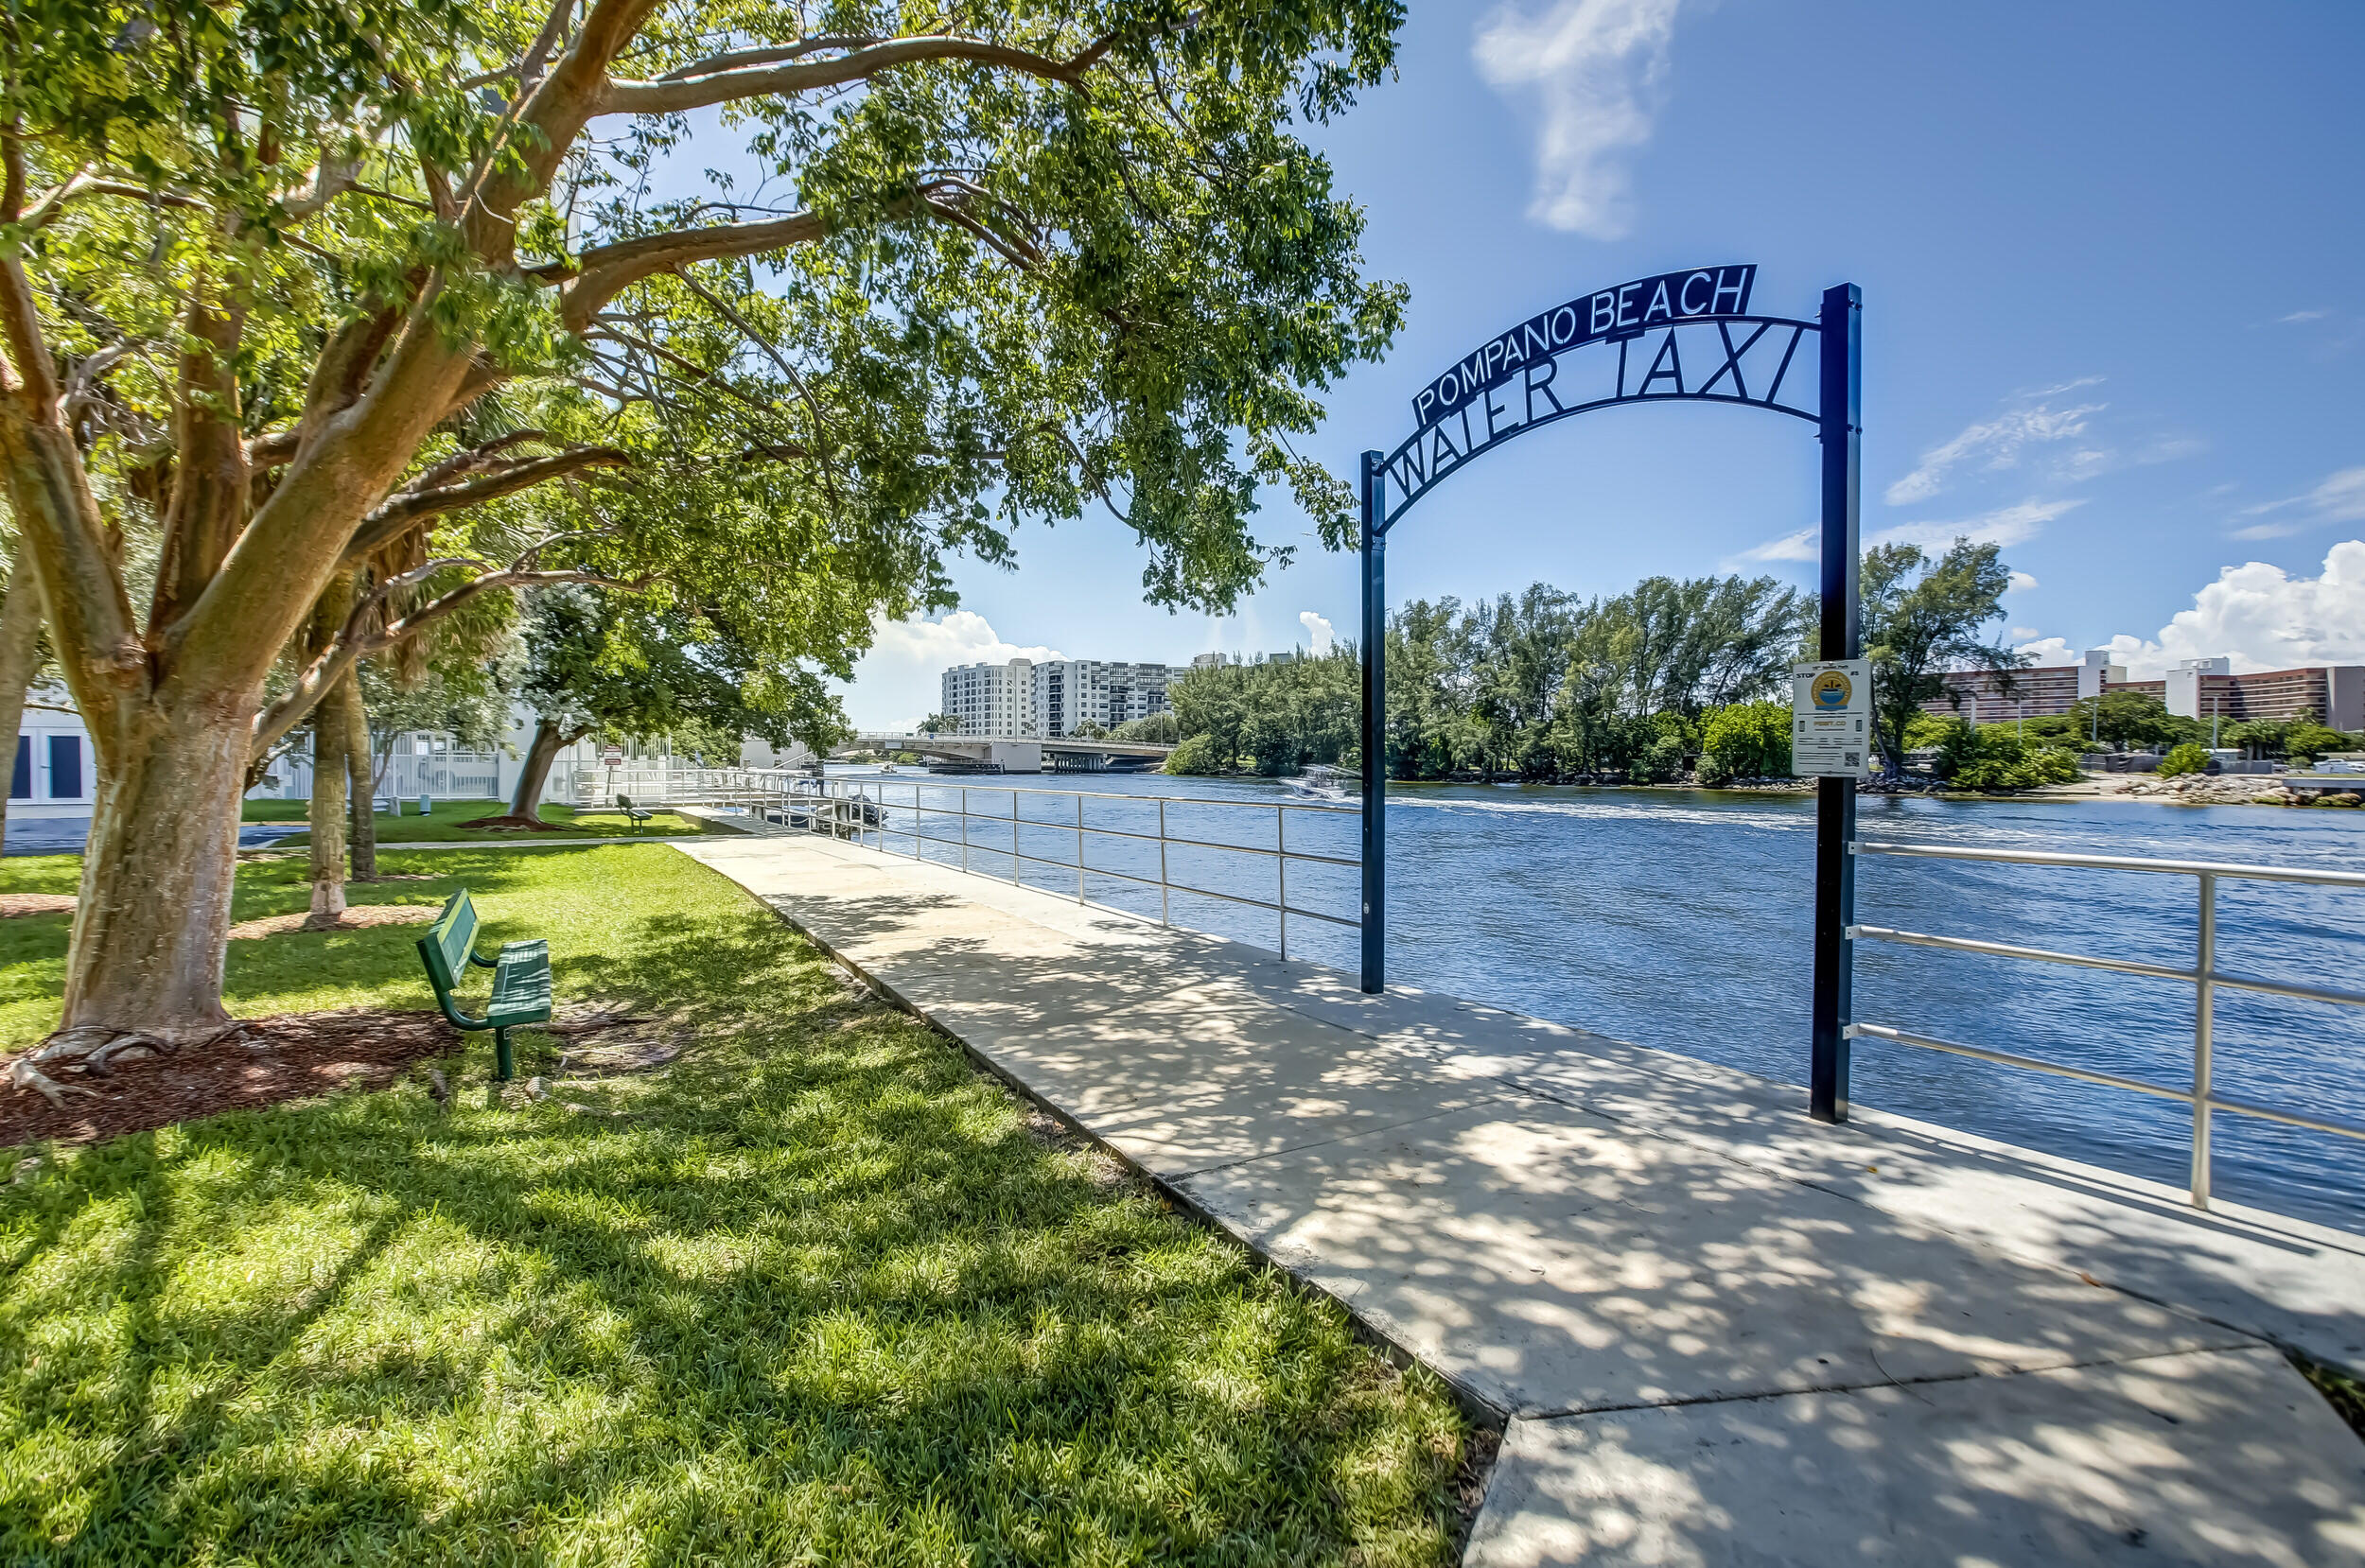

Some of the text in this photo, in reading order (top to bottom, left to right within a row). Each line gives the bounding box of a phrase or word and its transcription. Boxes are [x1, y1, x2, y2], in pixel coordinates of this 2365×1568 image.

[1386, 318, 1805, 499] WATER TAXI
[1416, 268, 1748, 426] POMPANO BEACH
